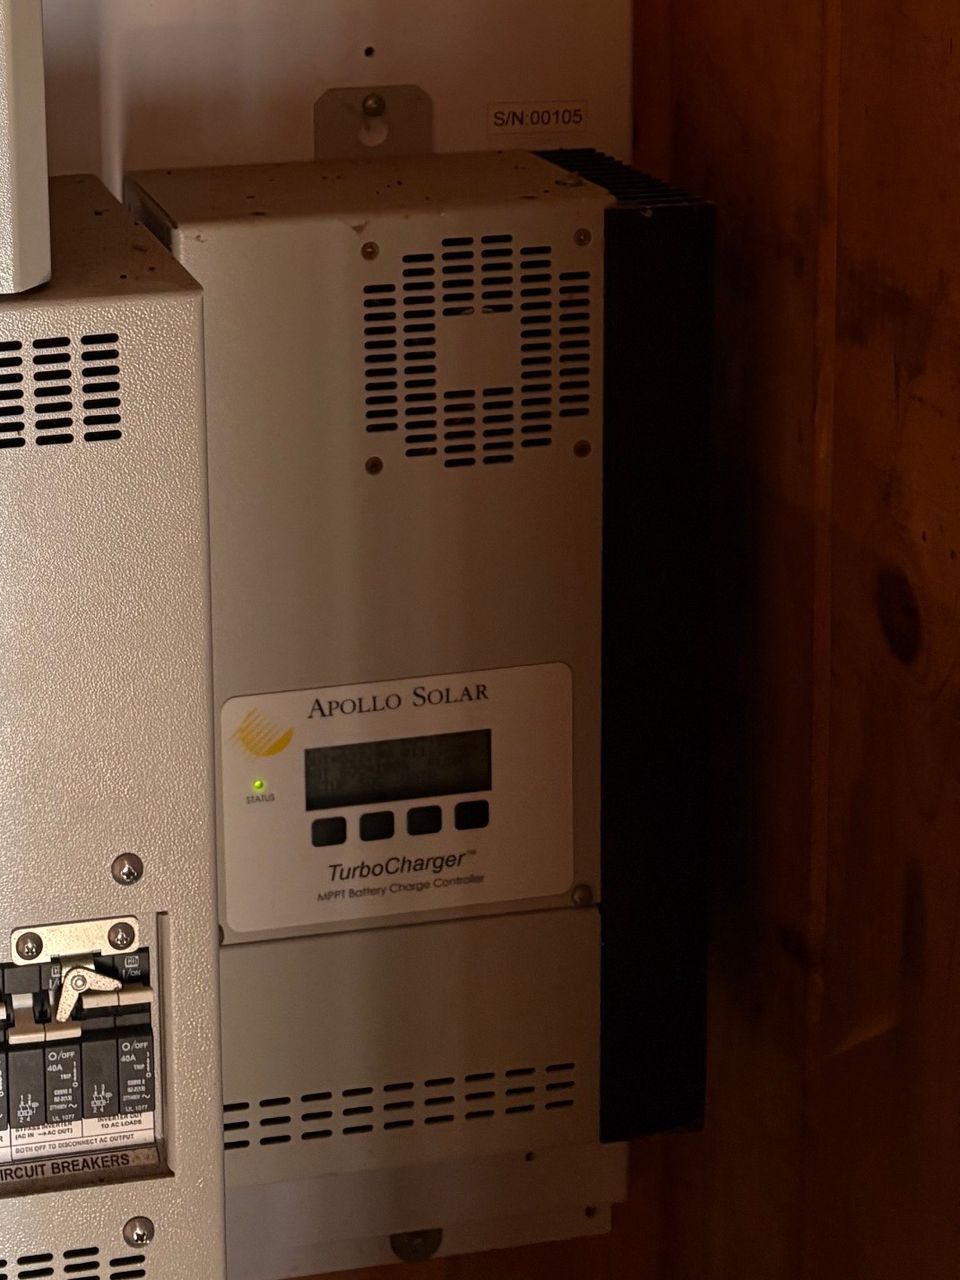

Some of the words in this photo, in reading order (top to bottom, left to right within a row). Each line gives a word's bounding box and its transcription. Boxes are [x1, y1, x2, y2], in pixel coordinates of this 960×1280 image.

[493, 109, 583, 127] S/N:00105
[307, 693, 402, 719] APOLLO
[412, 684, 488, 707] SOLAR
[247, 793, 275, 805] STATUS
[317, 891, 346, 902] MPPT
[349, 884, 387, 900] Battery
[390, 880, 431, 894] Charge
[433, 874, 485, 888] Controller
[120, 1054, 136, 1062] 40A
[121, 1119, 142, 1127] LOADS
[15, 1146, 33, 1154] BOTH
[34, 1144, 46, 1152] OFF
[58, 1138, 98, 1149] DISCONNECT
[109, 1134, 134, 1143] OUTPUT
[51, 1152, 130, 1175] BREAKERS
